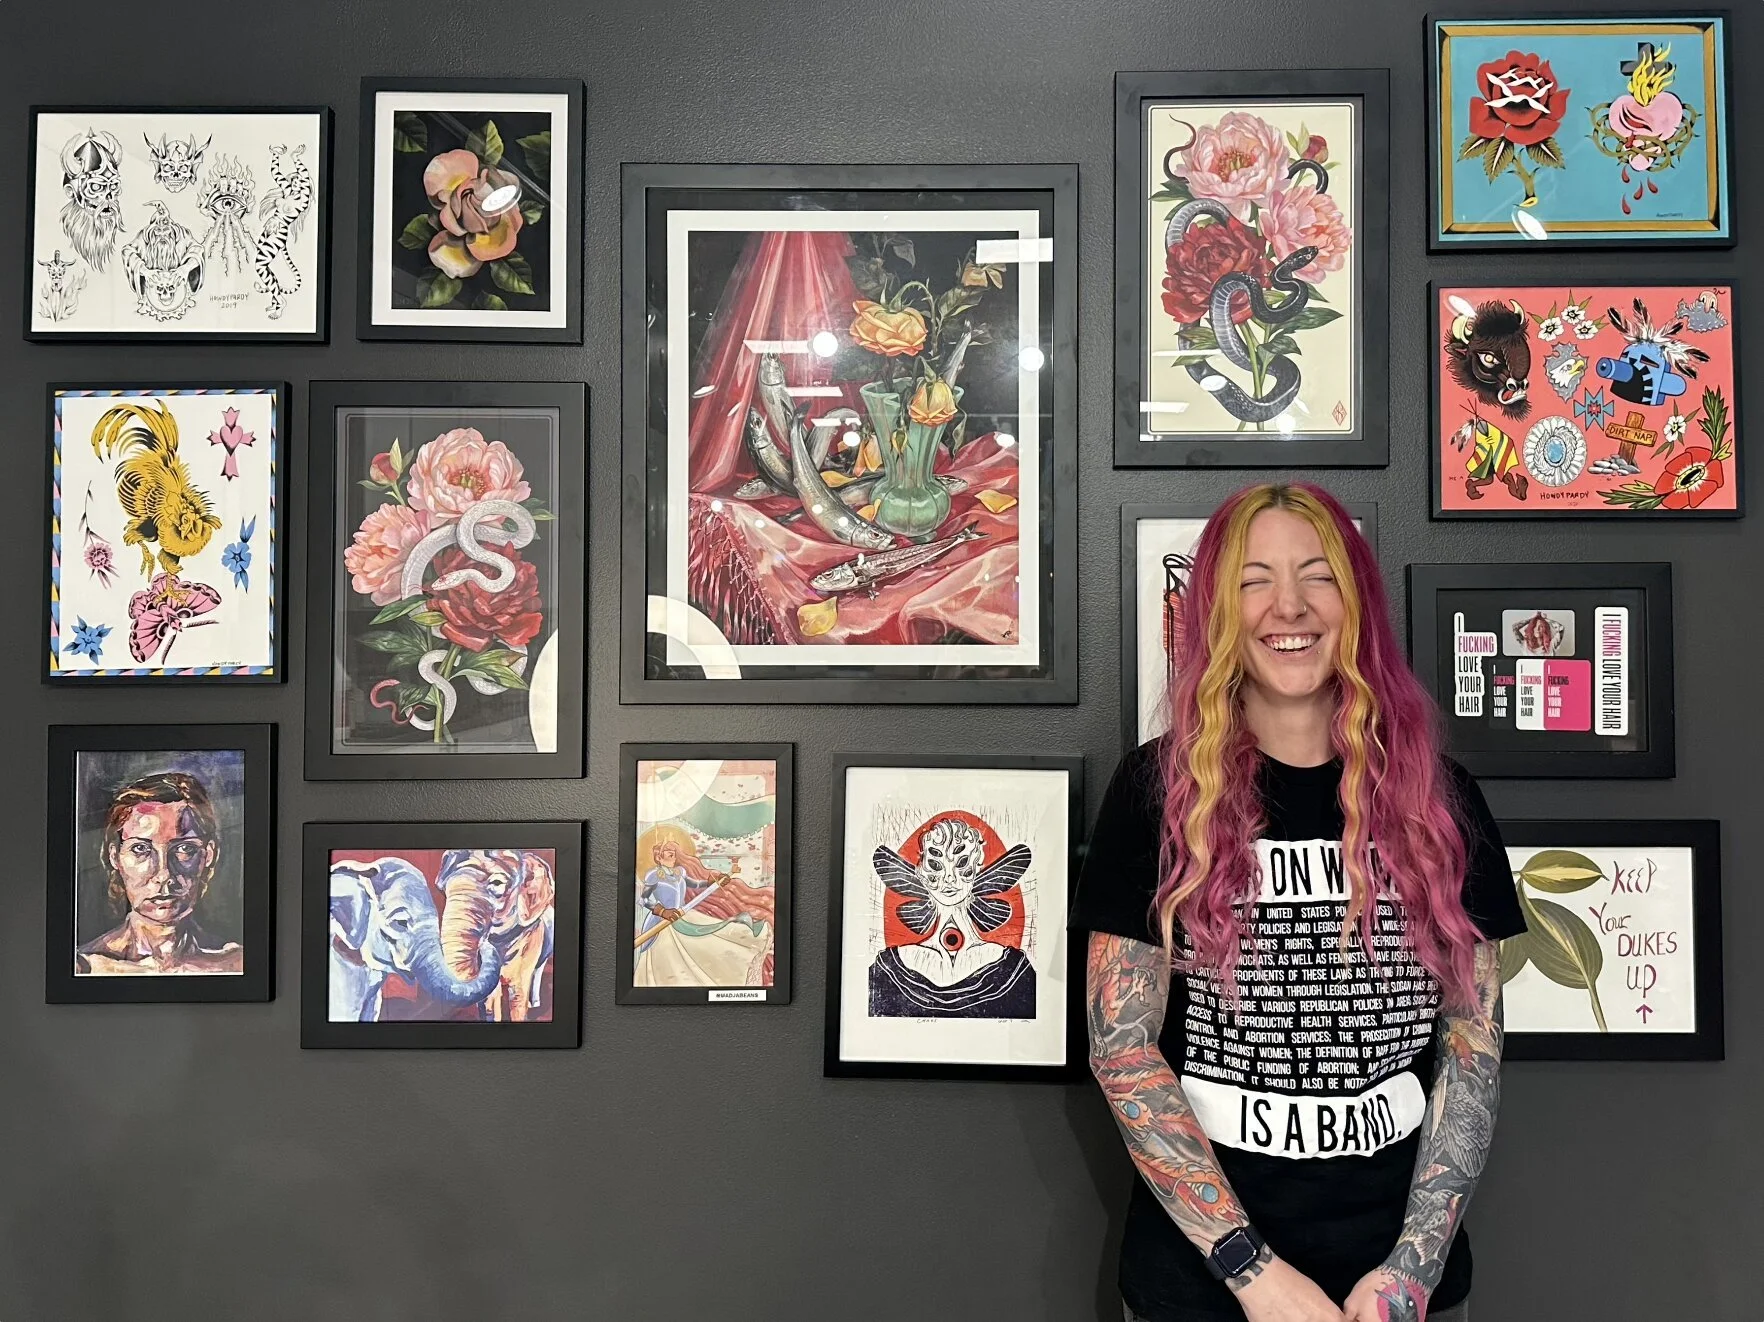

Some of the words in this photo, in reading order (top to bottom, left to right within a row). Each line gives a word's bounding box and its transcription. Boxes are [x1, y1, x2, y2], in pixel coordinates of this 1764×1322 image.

[1609, 427, 1630, 438] DIRT
[1634, 431, 1653, 442] NAP
[1458, 636, 1494, 653] FUCKING
[1602, 619, 1621, 656] FUCKING
[1458, 656, 1479, 672] LOVE
[1602, 659, 1621, 680] LOVE
[1459, 676, 1481, 692] YOUR
[1493, 675, 1515, 685] FUCKING
[1520, 676, 1541, 684] FUCKING
[1547, 675, 1569, 685] FUCKING
[1493, 686, 1506, 696] LOVE
[1520, 686, 1533, 695] LOVE
[1547, 686, 1560, 696] LOVE
[1602, 682, 1621, 705] YOUR
[1459, 696, 1480, 712] HAIR
[1493, 697, 1508, 707] YOUR
[1520, 697, 1534, 706] YOUR
[1547, 697, 1562, 707] YOUR
[1493, 708, 1507, 717] HAIR
[1520, 708, 1533, 717] HAIR
[1547, 708, 1561, 717] HAIR
[1602, 708, 1621, 729] HAIR
[1270, 847, 1312, 896] ON
[1266, 907, 1293, 919] UNITED
[1301, 905, 1330, 918] STATES
[1376, 904, 1393, 916] USED
[1588, 902, 1632, 935] Your
[1258, 922, 1292, 934] POLICIES
[1294, 922, 1311, 934] AND
[1284, 937, 1315, 951] RIGHTS,
[1617, 931, 1678, 957] DUKES
[1278, 954, 1289, 966] AS
[1291, 953, 1313, 966] WELL
[1315, 953, 1327, 965] AS
[1391, 950, 1409, 962] USED
[1232, 969, 1285, 982] PROPONENTS
[1288, 969, 1298, 982] OF
[1302, 968, 1327, 981] THESE
[1330, 967, 1353, 980] LAWS
[1355, 966, 1366, 979] AS
[1186, 977, 1208, 992] SOCIAL
[1237, 984, 1249, 997] ON
[1251, 985, 1284, 997] WOMEN
[1285, 984, 1322, 997] THROUGH
[1324, 982, 1374, 996] LEGISLATION.
[1374, 982, 1390, 994] THE
[1390, 980, 1412, 993] SLOGAN
[1412, 979, 1427, 991] HAS
[1188, 990, 1206, 1005] USED
[1206, 994, 1216, 1008] TO
[1261, 1000, 1297, 1013] VARIOUS
[1299, 998, 1349, 1012] REPUBLICAN
[1353, 997, 1383, 1011] POLICIES
[1428, 994, 1439, 1005] AS
[1186, 1004, 1212, 1022] ACCESS
[1217, 1012, 1228, 1025] TO
[1234, 1014, 1294, 1029] REPRODUCTIVE
[1300, 1015, 1332, 1028] HEALTH
[1337, 1014, 1378, 1028] SERVICES,
[1223, 1026, 1239, 1040] AND
[1244, 1030, 1285, 1044] ABORTION
[1337, 1030, 1355, 1043] THE
[1360, 1027, 1402, 1043] PROSECUTION
[1186, 1032, 1221, 1050] VIOLENCE
[1223, 1040, 1255, 1058] AGAINST
[1258, 1046, 1293, 1061] WOMEN;
[1296, 1047, 1312, 1059] THE
[1315, 1045, 1359, 1059] DEFINITION
[1362, 1046, 1373, 1059] OF
[1186, 1045, 1198, 1058] OF
[1203, 1049, 1218, 1063] THE
[1223, 1054, 1250, 1071] PUBLIC
[1256, 1061, 1292, 1075] FUNDING
[1298, 1062, 1310, 1075] OF
[1184, 1060, 1247, 1083] DISCRIMINATION.
[1251, 1075, 1260, 1086] IT
[1264, 1077, 1297, 1090] SHOULD
[1301, 1077, 1324, 1090] ALSO
[1327, 1077, 1340, 1090] BE
[1240, 1094, 1273, 1148] IS
[1283, 1102, 1306, 1154] A
[1317, 1093, 1402, 1152] BAND.
